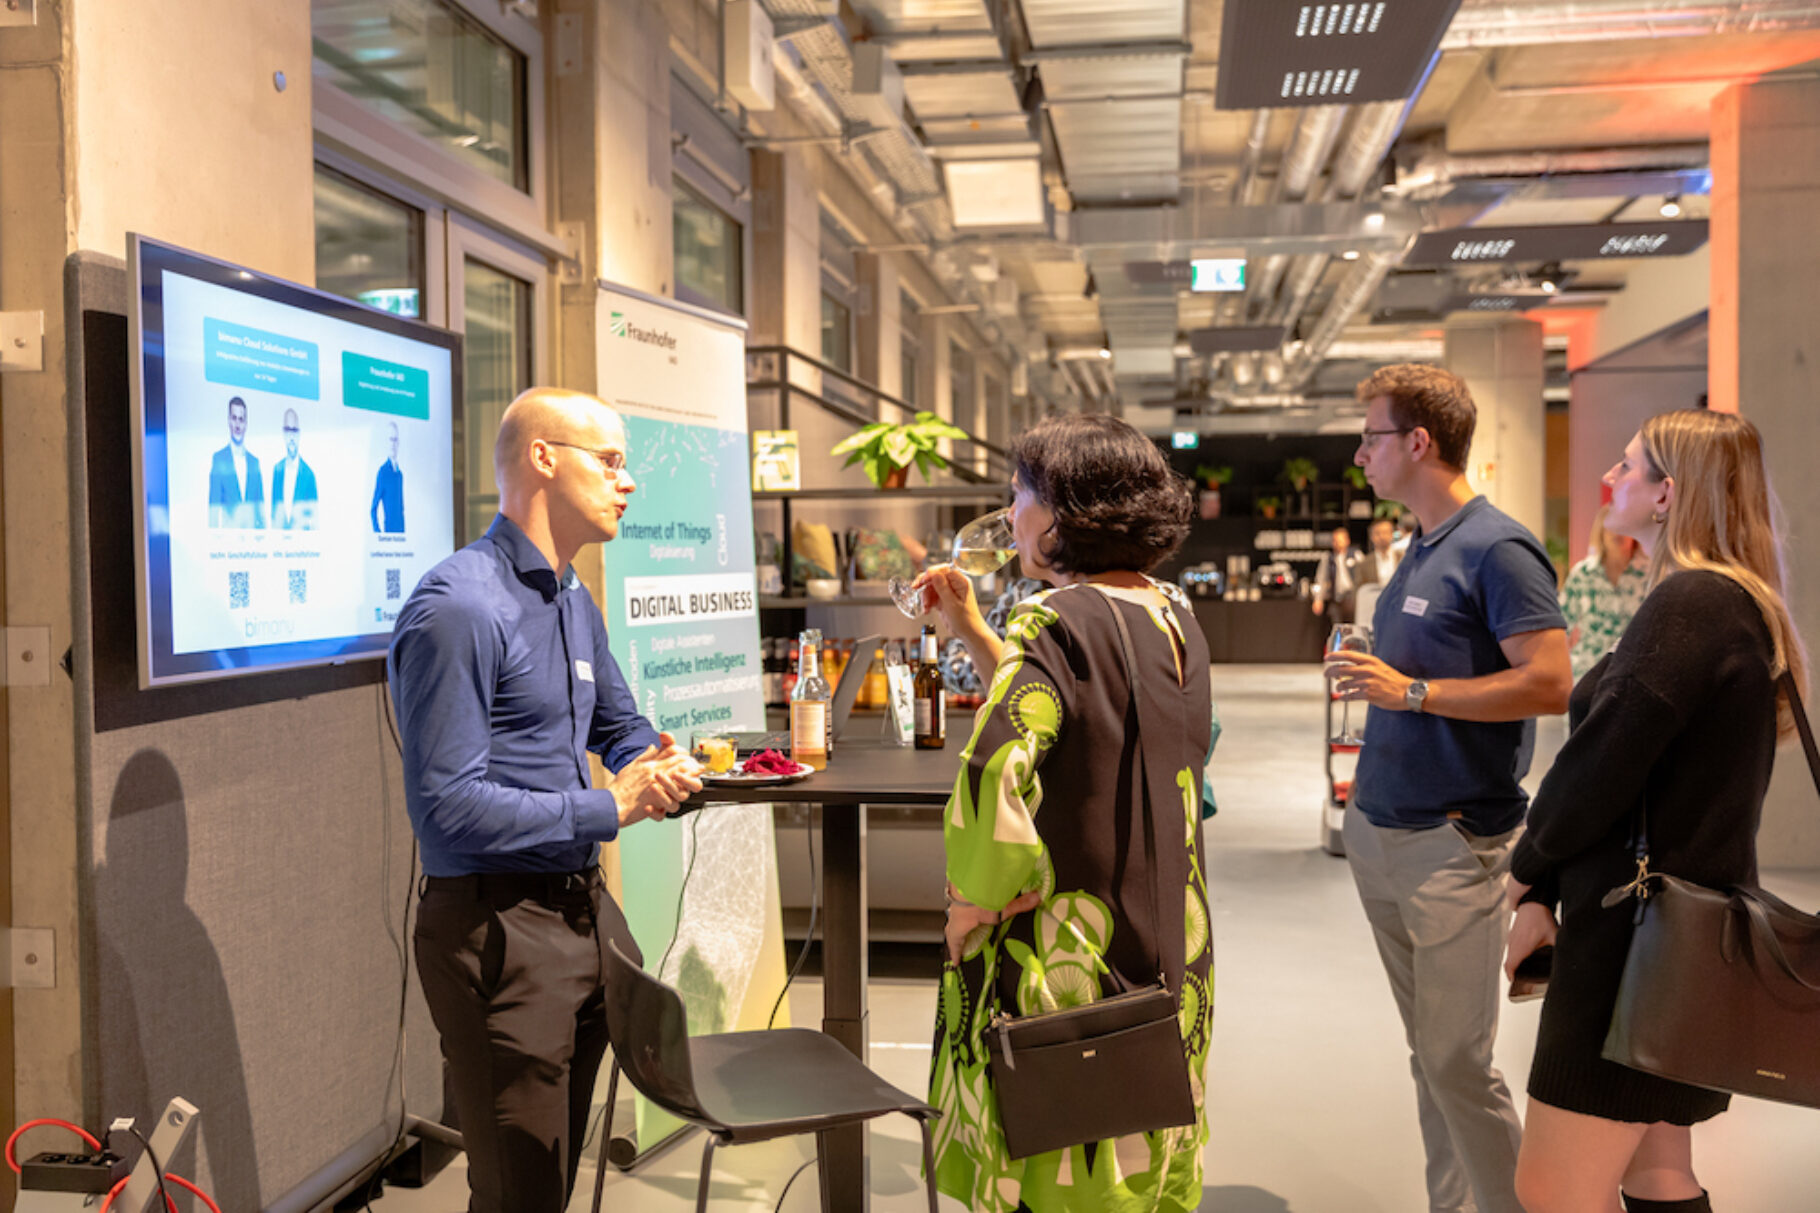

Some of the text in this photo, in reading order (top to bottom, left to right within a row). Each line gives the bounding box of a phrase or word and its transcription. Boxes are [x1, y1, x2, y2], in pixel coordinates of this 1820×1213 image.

[627, 322, 677, 350] Fraunhofer
[622, 521, 712, 545] Internet of Things
[716, 513, 728, 566] Cloud
[630, 591, 752, 619] DIGITAL BUSINESS
[643, 651, 746, 680] Künstliche Intelligenz
[660, 711, 688, 731] Smart
[691, 704, 732, 727] Services
